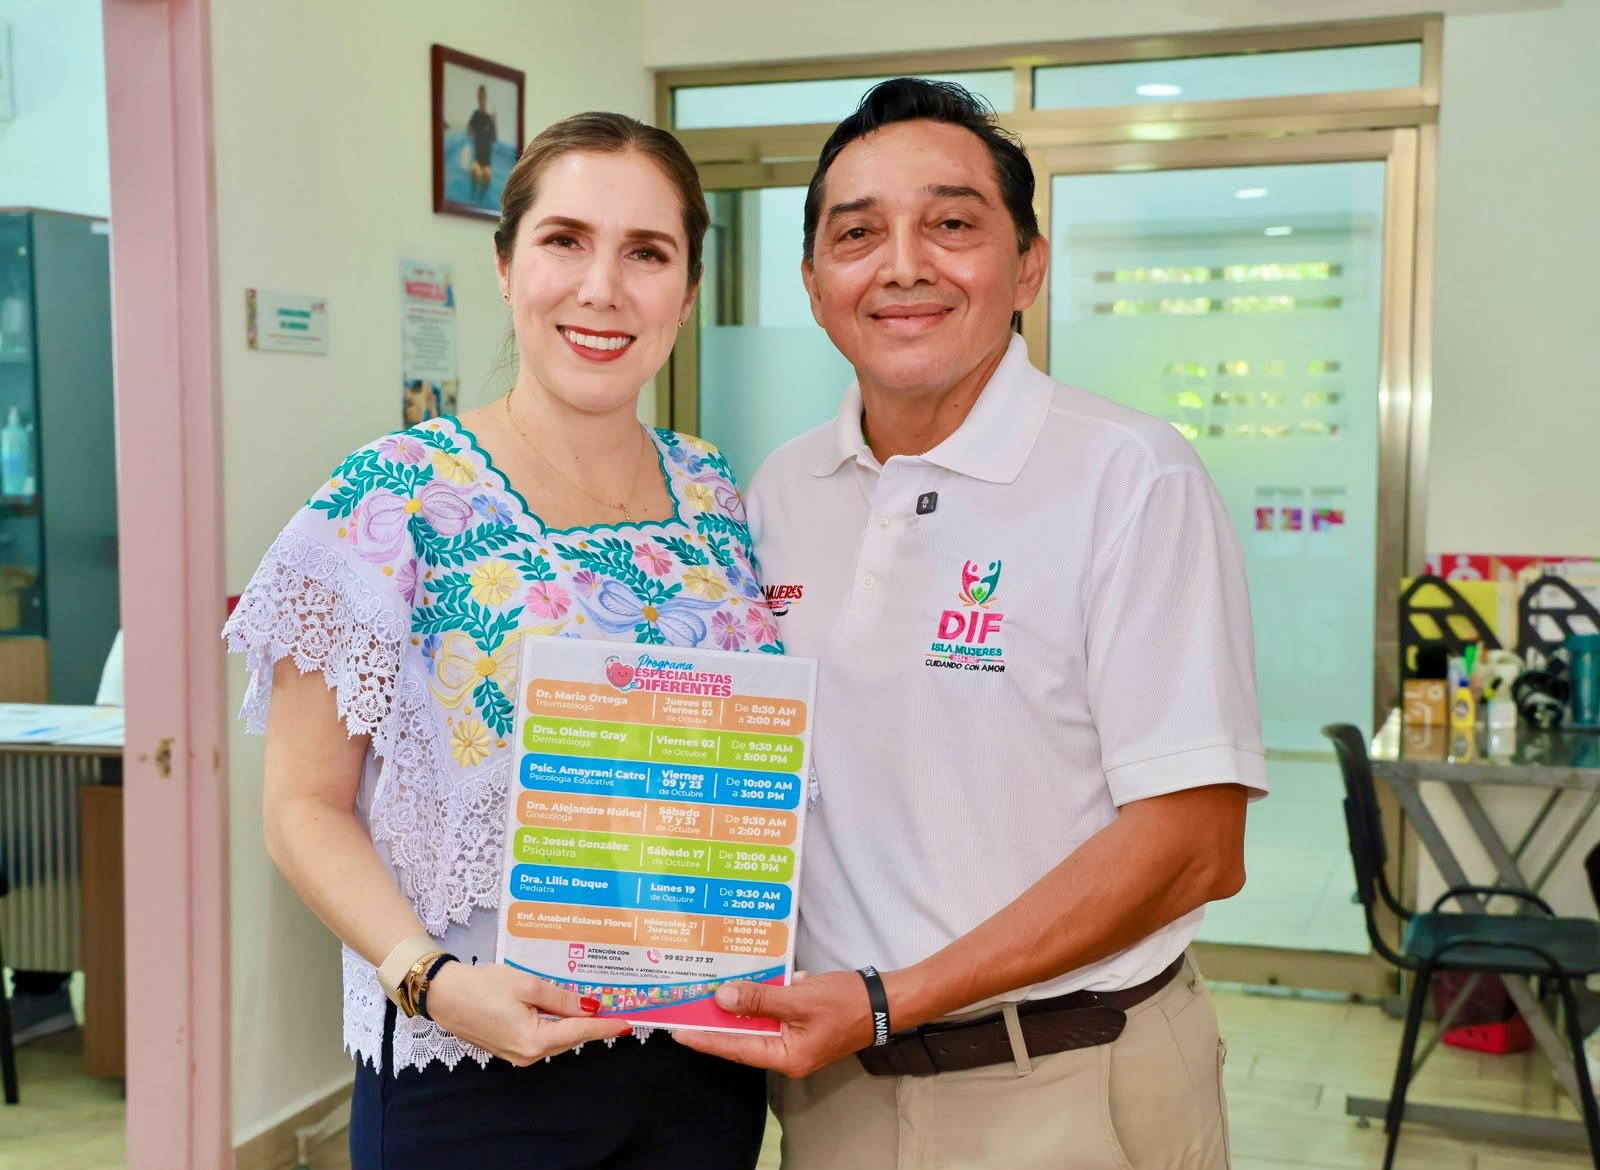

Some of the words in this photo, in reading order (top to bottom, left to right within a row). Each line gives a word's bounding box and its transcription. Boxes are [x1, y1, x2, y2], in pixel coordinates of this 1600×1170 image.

[937, 610, 1004, 644] DIF
[931, 642, 952, 653] ISLA
[955, 645, 1002, 657] MUJERES
[637, 653, 694, 671] Programa
[925, 659, 962, 669] CUIDANDO
[981, 664, 1005, 673] AMOR
[634, 667, 732, 685] ESPECIALISTAS
[636, 680, 732, 697] DIFERENTES
[536, 689, 551, 699] Dr.
[555, 691, 586, 701] Mario
[589, 693, 628, 706] Ortega
[665, 697, 699, 708] Jueves
[702, 701, 712, 709] 01
[536, 698, 593, 711] Traumatólogo
[735, 703, 749, 712] De
[751, 705, 775, 715] 8:30
[777, 707, 796, 716] AM
[701, 708, 713, 717] 02
[678, 715, 708, 724] Octubre
[746, 715, 770, 725] 2:00
[773, 718, 791, 727] PM
[533, 724, 556, 735] Dra.
[560, 726, 597, 738] Olaine
[600, 730, 627, 742] Gray
[532, 735, 591, 747] Dermatóloga
[656, 735, 699, 747] Viernes
[701, 740, 715, 749] 02
[731, 741, 746, 750] De
[748, 742, 772, 752] 9:30
[775, 744, 793, 753] AM
[674, 749, 708, 758] Octubre
[743, 752, 768, 762] 5:00
[770, 755, 788, 764] PM
[529, 763, 556, 774] Psic.
[559, 765, 613, 778] Amayrani
[615, 770, 646, 780] Catro
[662, 769, 704, 781] Viernes
[573, 777, 615, 787] Educativs
[662, 778, 676, 788] 09
[679, 782, 687, 790] y
[688, 781, 702, 790] 23
[726, 778, 741, 787] De
[743, 779, 772, 788] 10:00
[774, 781, 793, 790] AM
[659, 788, 669, 796] de
[671, 788, 704, 798] Octubre
[740, 789, 765, 799] 3:00
[767, 791, 785, 801] PM
[526, 800, 549, 811] Dra.
[551, 803, 605, 816] Alejandra
[607, 806, 643, 818] Núñez
[658, 806, 700, 818] Sábado
[525, 810, 573, 822] Ginecóloga
[661, 815, 674, 824] 17
[675, 818, 684, 827] y
[685, 817, 697, 826] 31
[725, 814, 741, 824] De
[742, 815, 766, 826] 9:30
[768, 818, 787, 827] AM
[655, 824, 666, 832] de
[668, 825, 701, 835] Octubre
[737, 827, 761, 836] 2:00
[763, 828, 781, 838] PM
[523, 835, 539, 845] Dr.
[542, 836, 576, 848] Josué
[578, 839, 630, 852] González
[523, 845, 577, 859] Psiquiatra
[647, 845, 690, 857] Sábado
[693, 850, 705, 859] 17
[719, 850, 734, 859] De
[736, 851, 766, 861] 10:00
[768, 854, 788, 864] AM
[652, 858, 663, 866] de
[665, 859, 701, 869] Octubre
[733, 861, 759, 871] 2:00
[761, 863, 780, 873] PM
[520, 874, 543, 884] Dra.
[546, 876, 569, 886] Lilia
[571, 878, 609, 890] Duque
[651, 882, 682, 893] Lunes
[685, 885, 696, 894] 19
[520, 883, 555, 894] Pediatra
[719, 888, 734, 897] De
[736, 889, 760, 899] 9:30
[762, 891, 781, 901] AM
[650, 893, 660, 901] de
[662, 894, 694, 903] Octubre
[722, 900, 729, 908] a
[731, 899, 756, 909] 2:00
[758, 901, 775, 911] PM
[516, 920, 562, 930] Audiometría
[517, 912, 536, 921] Enf.
[537, 912, 571, 924] Anabel
[572, 916, 602, 926] Eslava
[604, 918, 633, 928] Flores
[644, 918, 687, 929] Miércoles
[689, 921, 698, 929] 21
[723, 917, 735, 925] De
[758, 920, 772, 928] PM
[647, 925, 678, 936] Jueves
[723, 936, 734, 944] De
[588, 946, 617, 956] ATENCIÓN
[753, 946, 767, 954] PM
